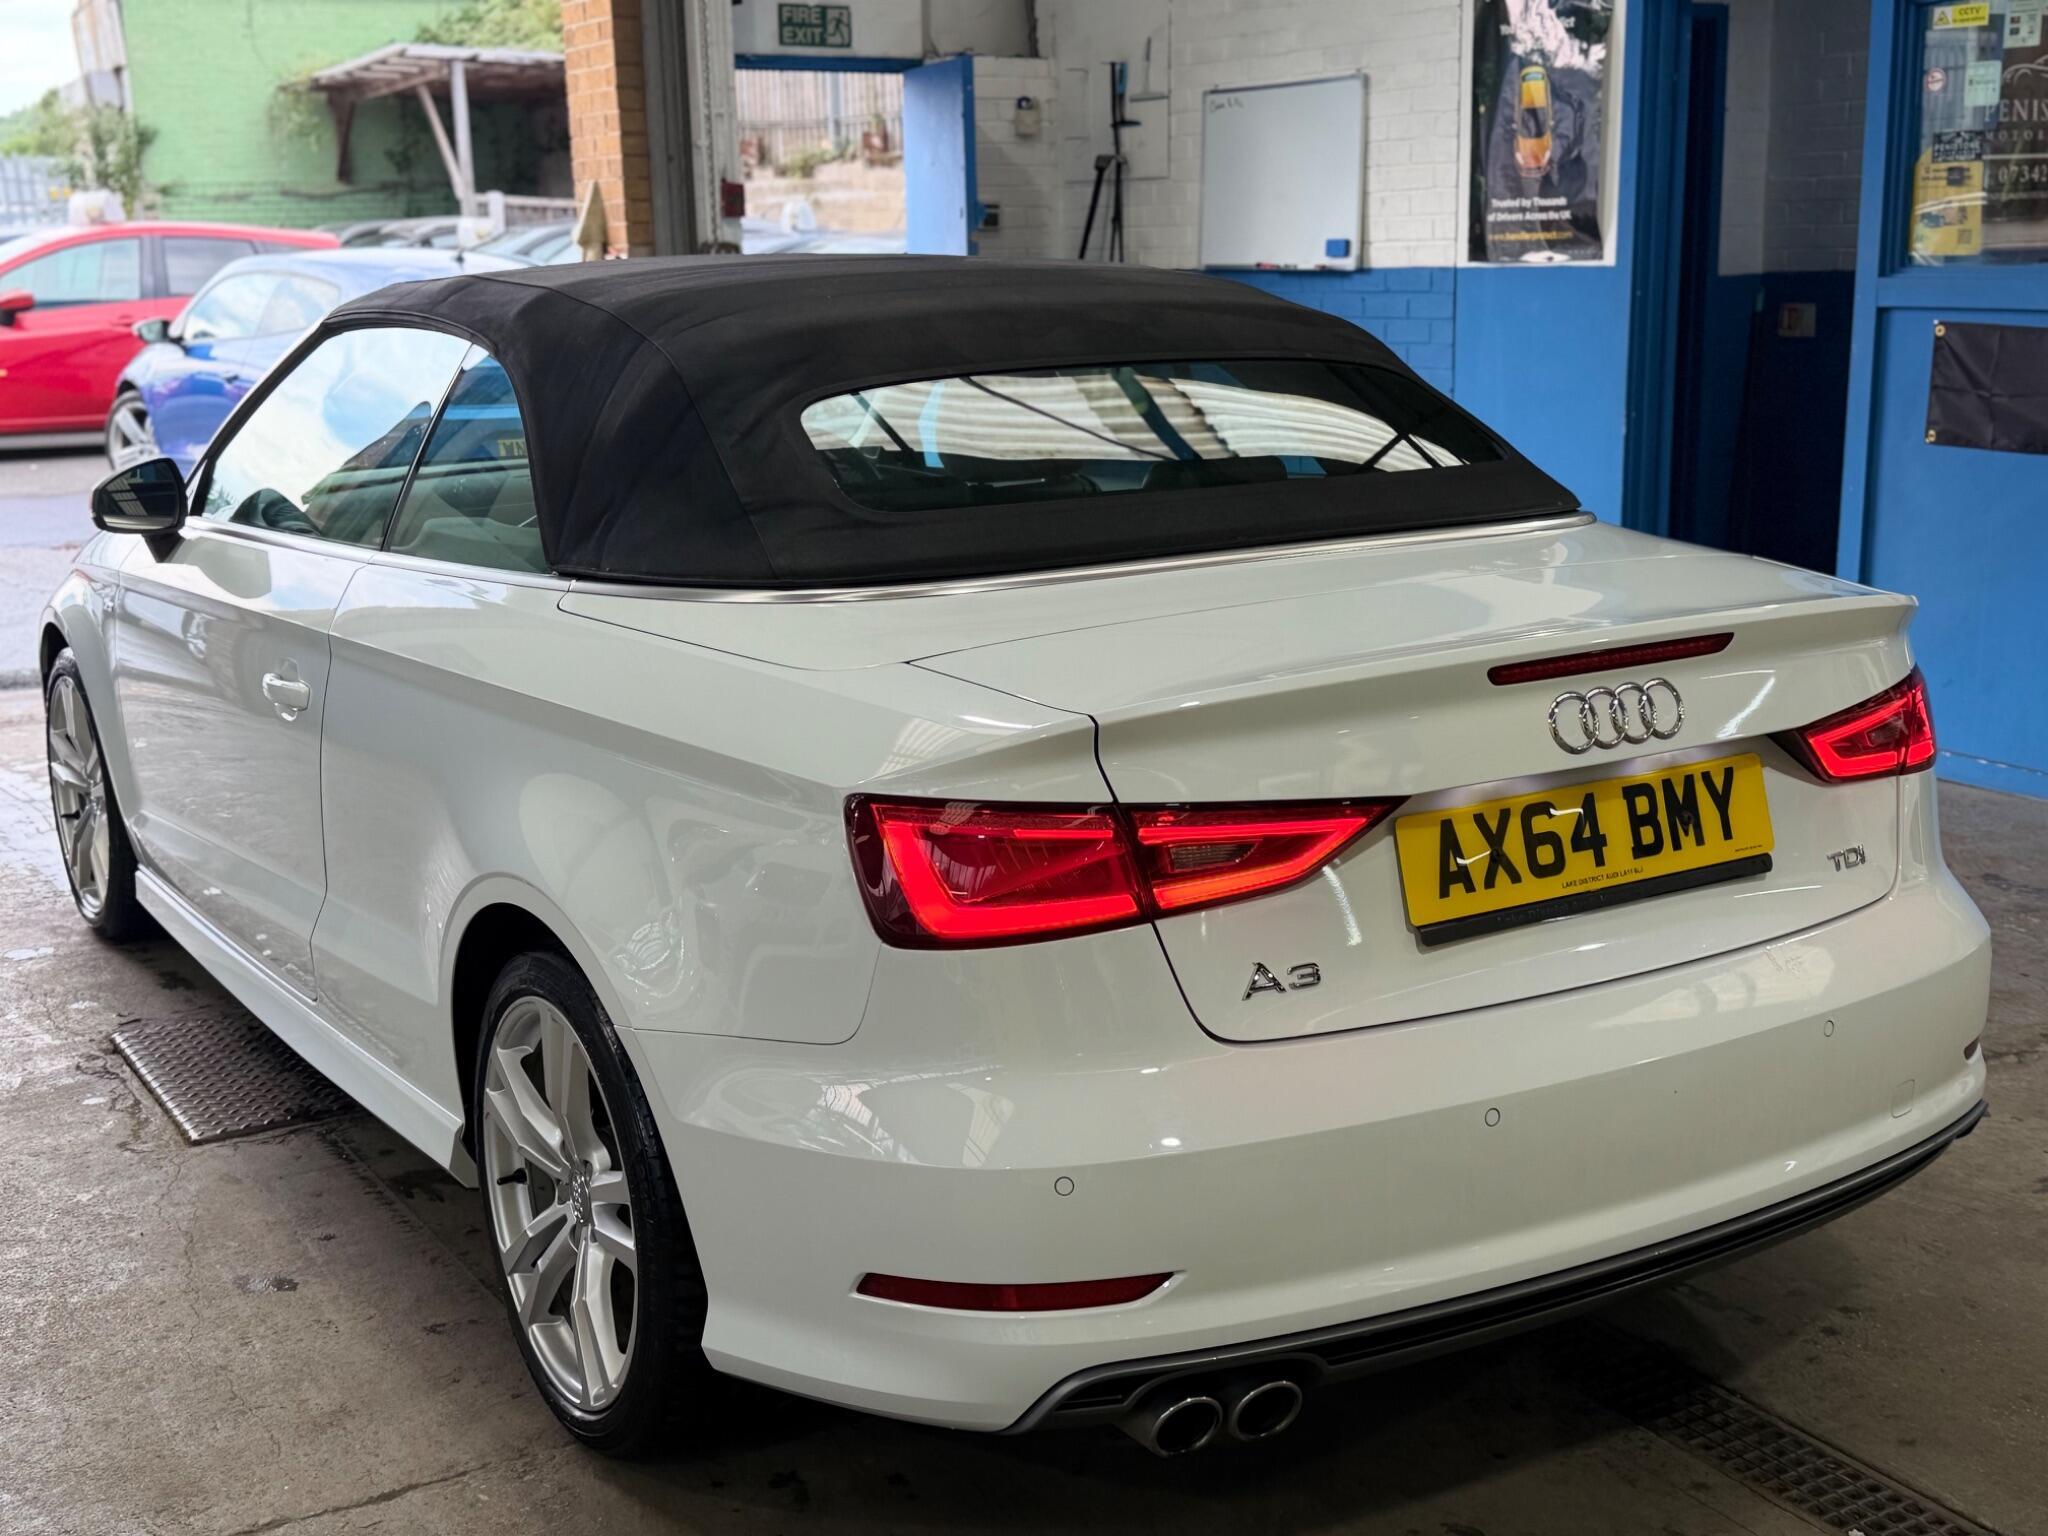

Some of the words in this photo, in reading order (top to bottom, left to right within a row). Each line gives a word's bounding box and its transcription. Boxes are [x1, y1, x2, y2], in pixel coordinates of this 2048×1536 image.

[782, 6, 821, 24] FIRE
[1958, 6, 1981, 16] CCTV
[782, 27, 822, 43] EXIT
[1520, 198, 1532, 209] by
[1487, 211, 1496, 221] of
[1439, 792, 1607, 899] AX64
[1622, 767, 1734, 860] BMY
[1562, 880, 1578, 888] LAKE
[1579, 873, 1604, 886] DISTRICT
[1606, 871, 1619, 880] AUDI
[1242, 962, 1321, 1001] A3
